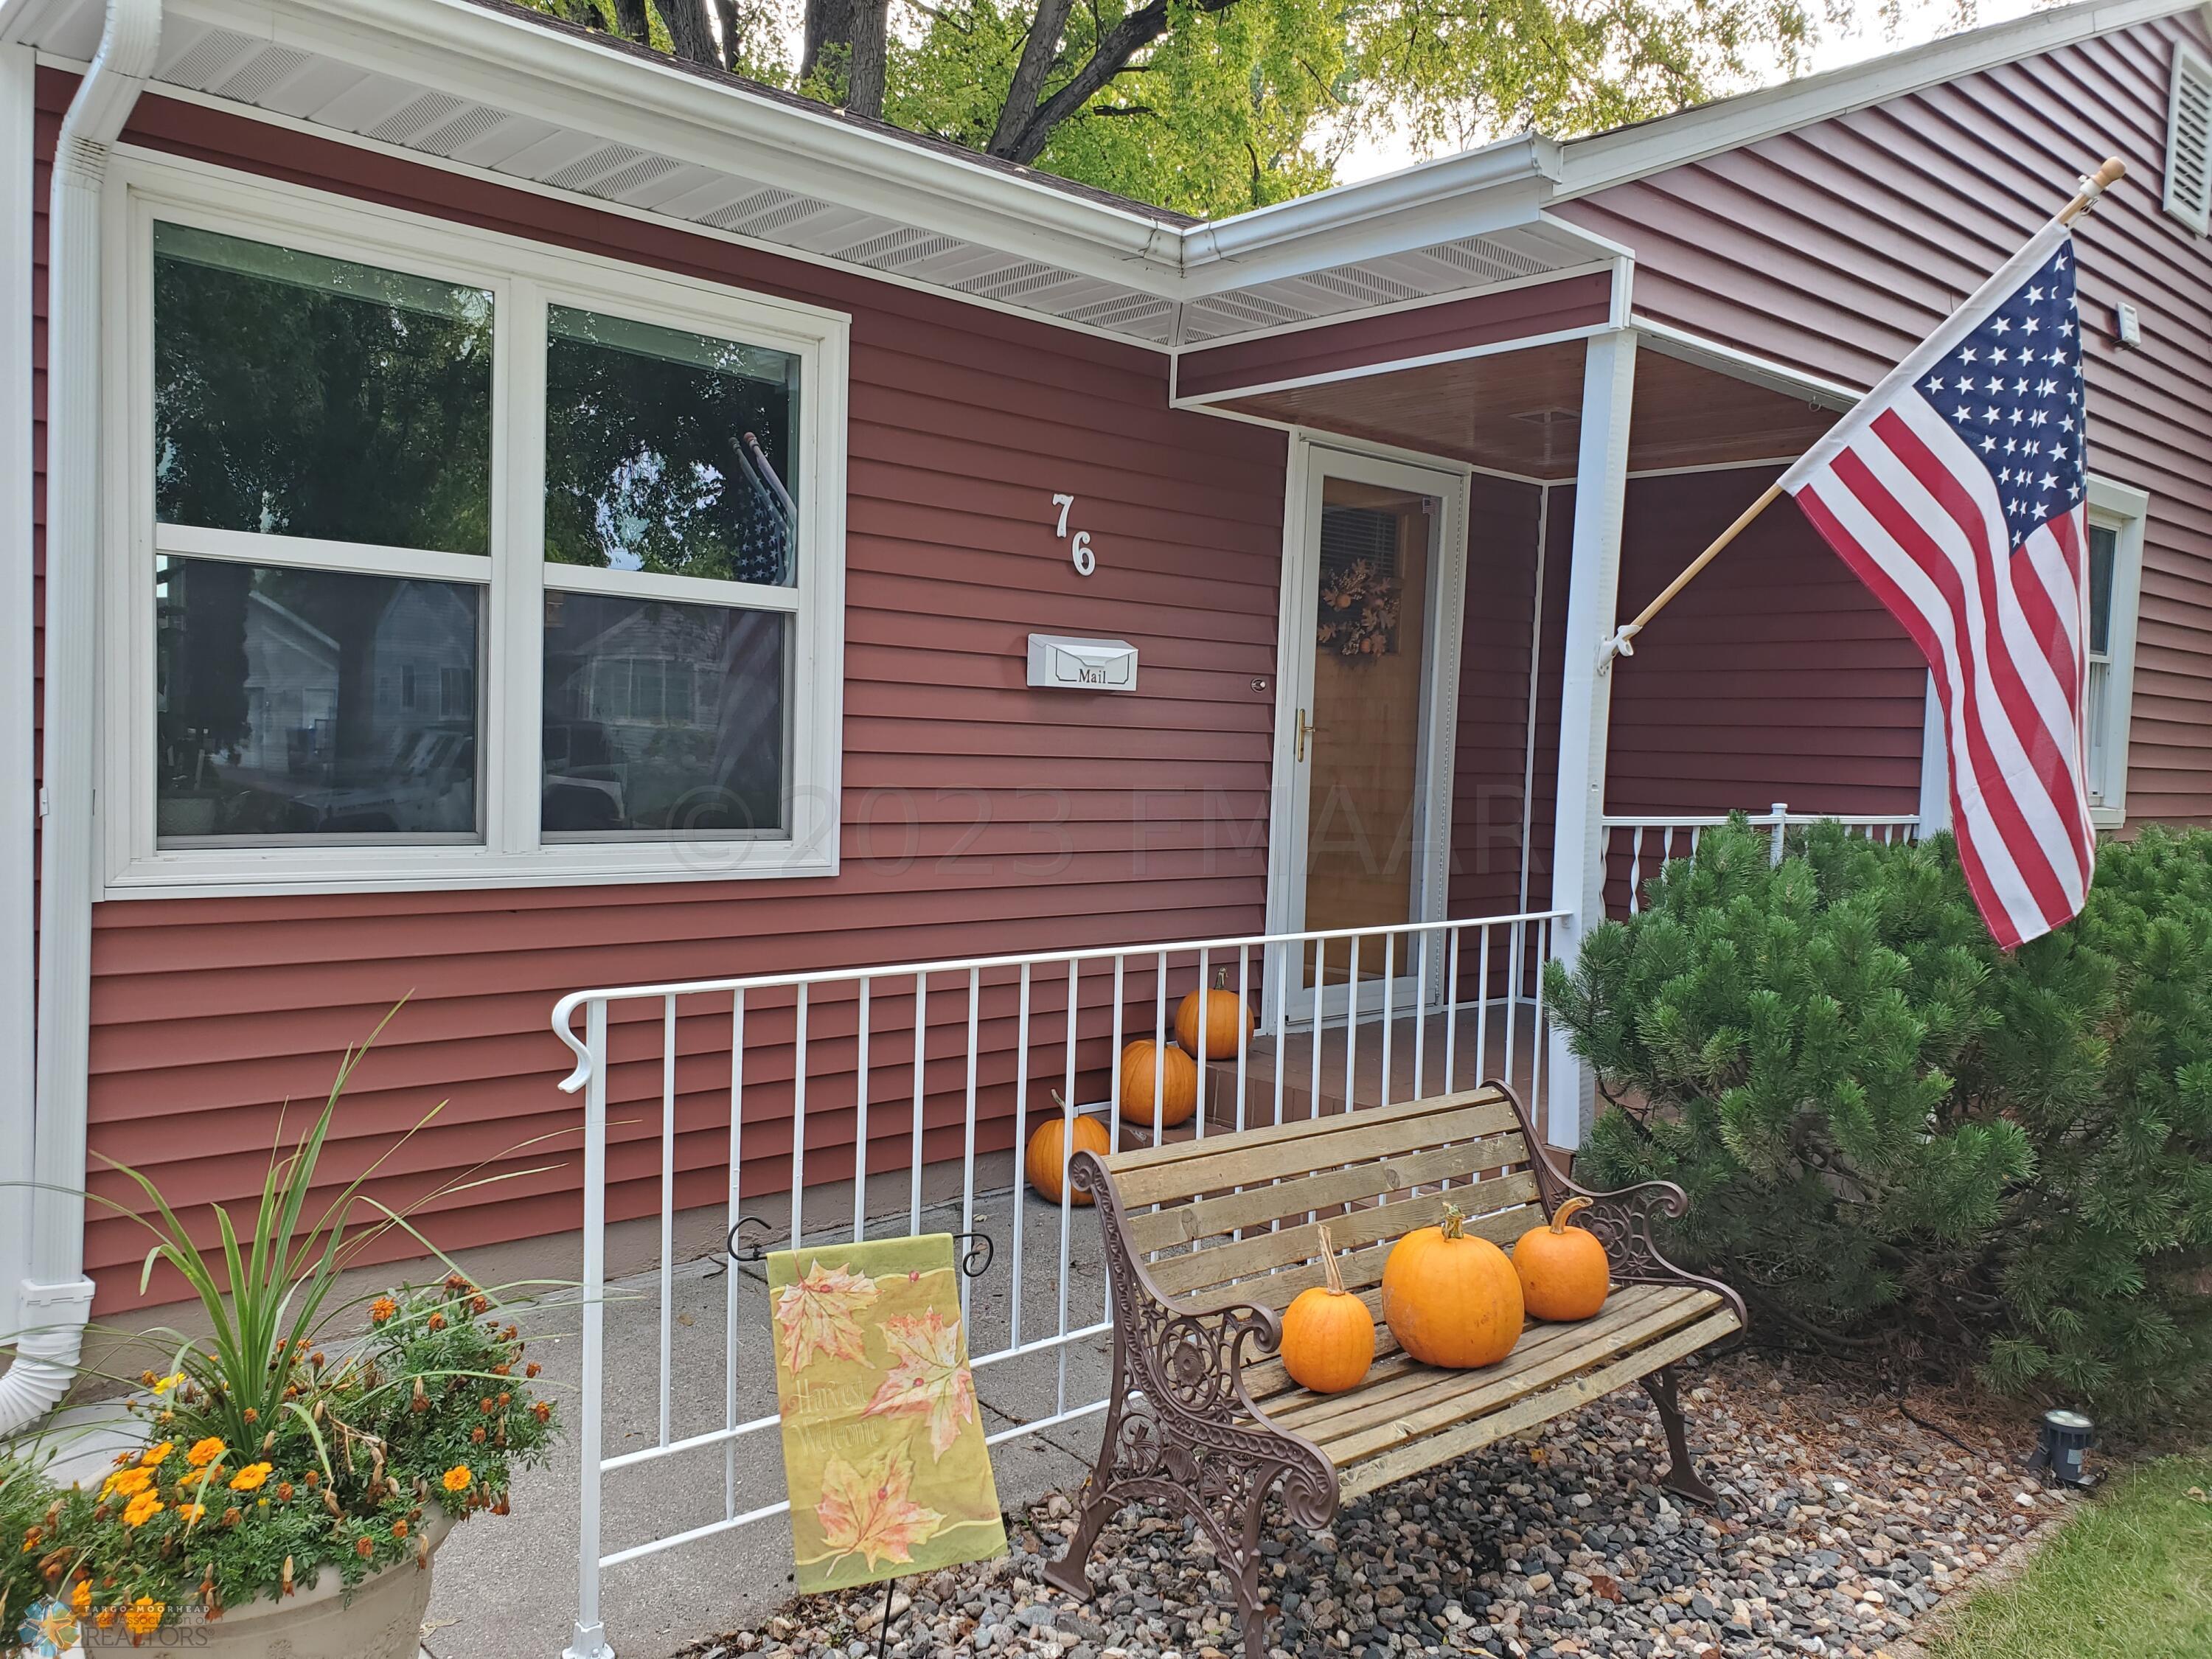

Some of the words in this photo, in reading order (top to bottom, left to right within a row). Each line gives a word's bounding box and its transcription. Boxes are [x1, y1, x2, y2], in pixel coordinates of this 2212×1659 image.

[1079, 669, 1107, 684] Mail
[787, 1376, 867, 1413] Harvest
[790, 1416, 879, 1456] Welcome
